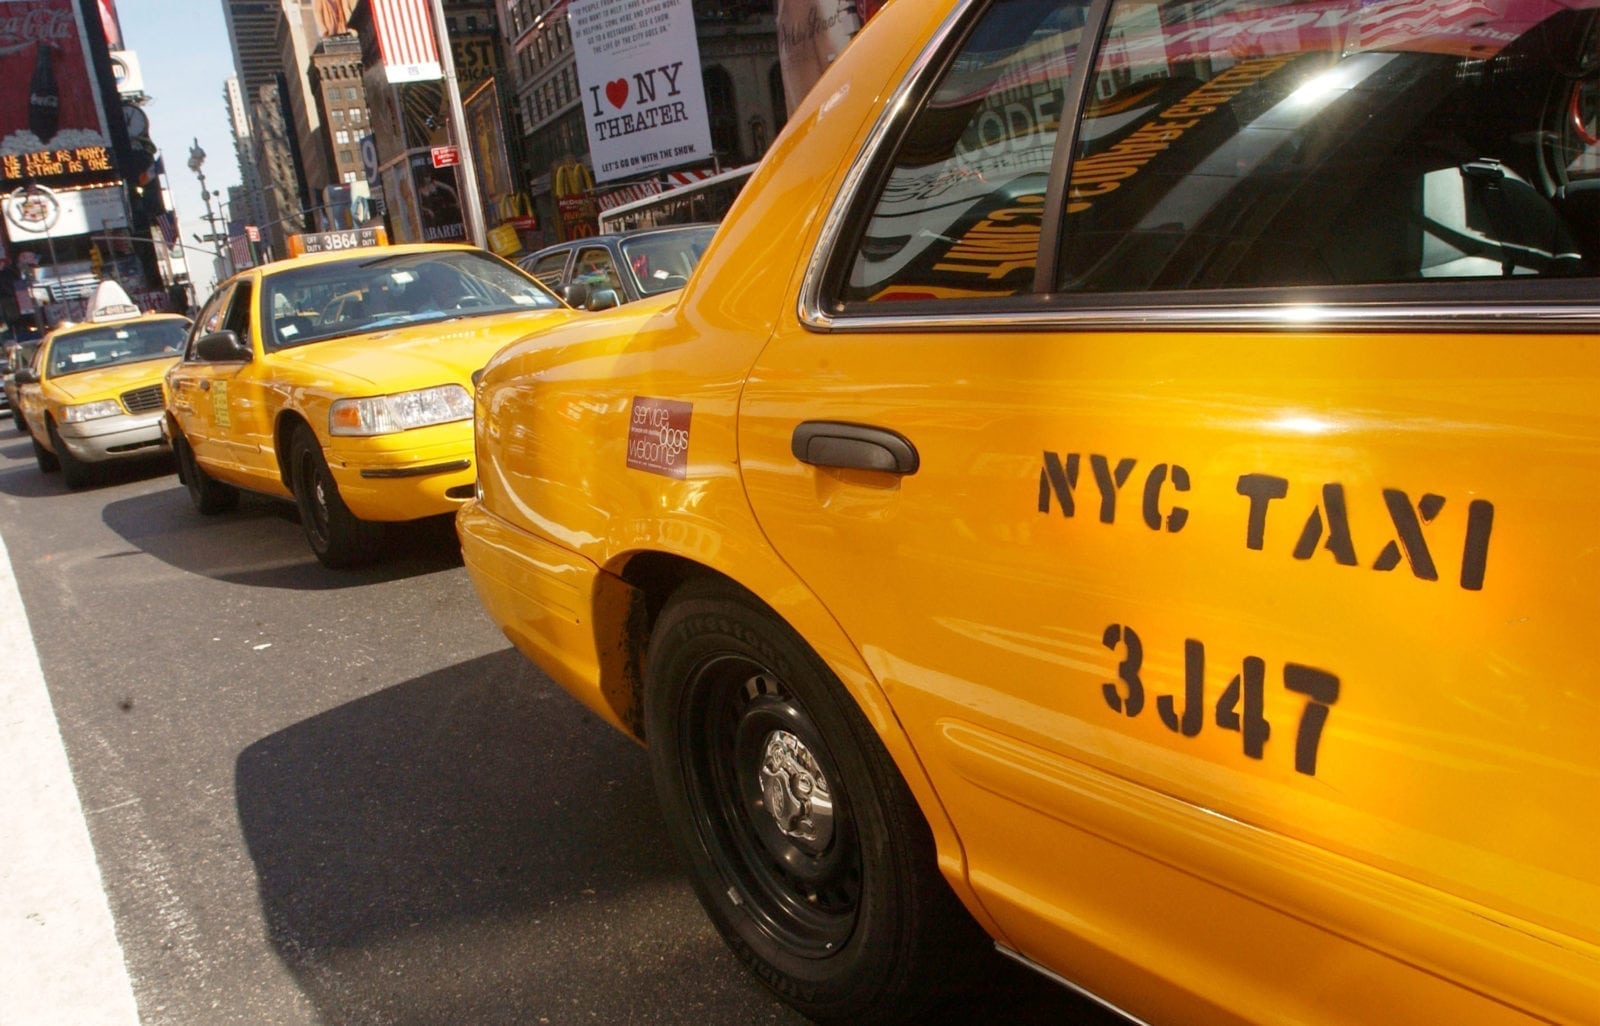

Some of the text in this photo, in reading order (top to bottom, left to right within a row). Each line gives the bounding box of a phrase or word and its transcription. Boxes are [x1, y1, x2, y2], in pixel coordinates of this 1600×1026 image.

[453, 40, 491, 67] EST
[590, 61, 683, 117] I NY
[595, 101, 688, 141] THEATER
[55, 149, 72, 162] AS
[620, 159, 630, 168] GO
[630, 157, 640, 166] ON
[640, 151, 659, 163] WITH
[659, 148, 673, 158] THE
[674, 144, 696, 157] SHOW.
[4, 166, 23, 179] WE
[26, 162, 63, 177] STAND
[69, 160, 84, 174] AS
[306, 236, 317, 244] OFF
[324, 233, 358, 250] 3B64
[424, 223, 465, 240] ABARET
[633, 402, 669, 427] service
[1038, 450, 1495, 591] NYC TAXI
[1102, 623, 1340, 777] 3J47
